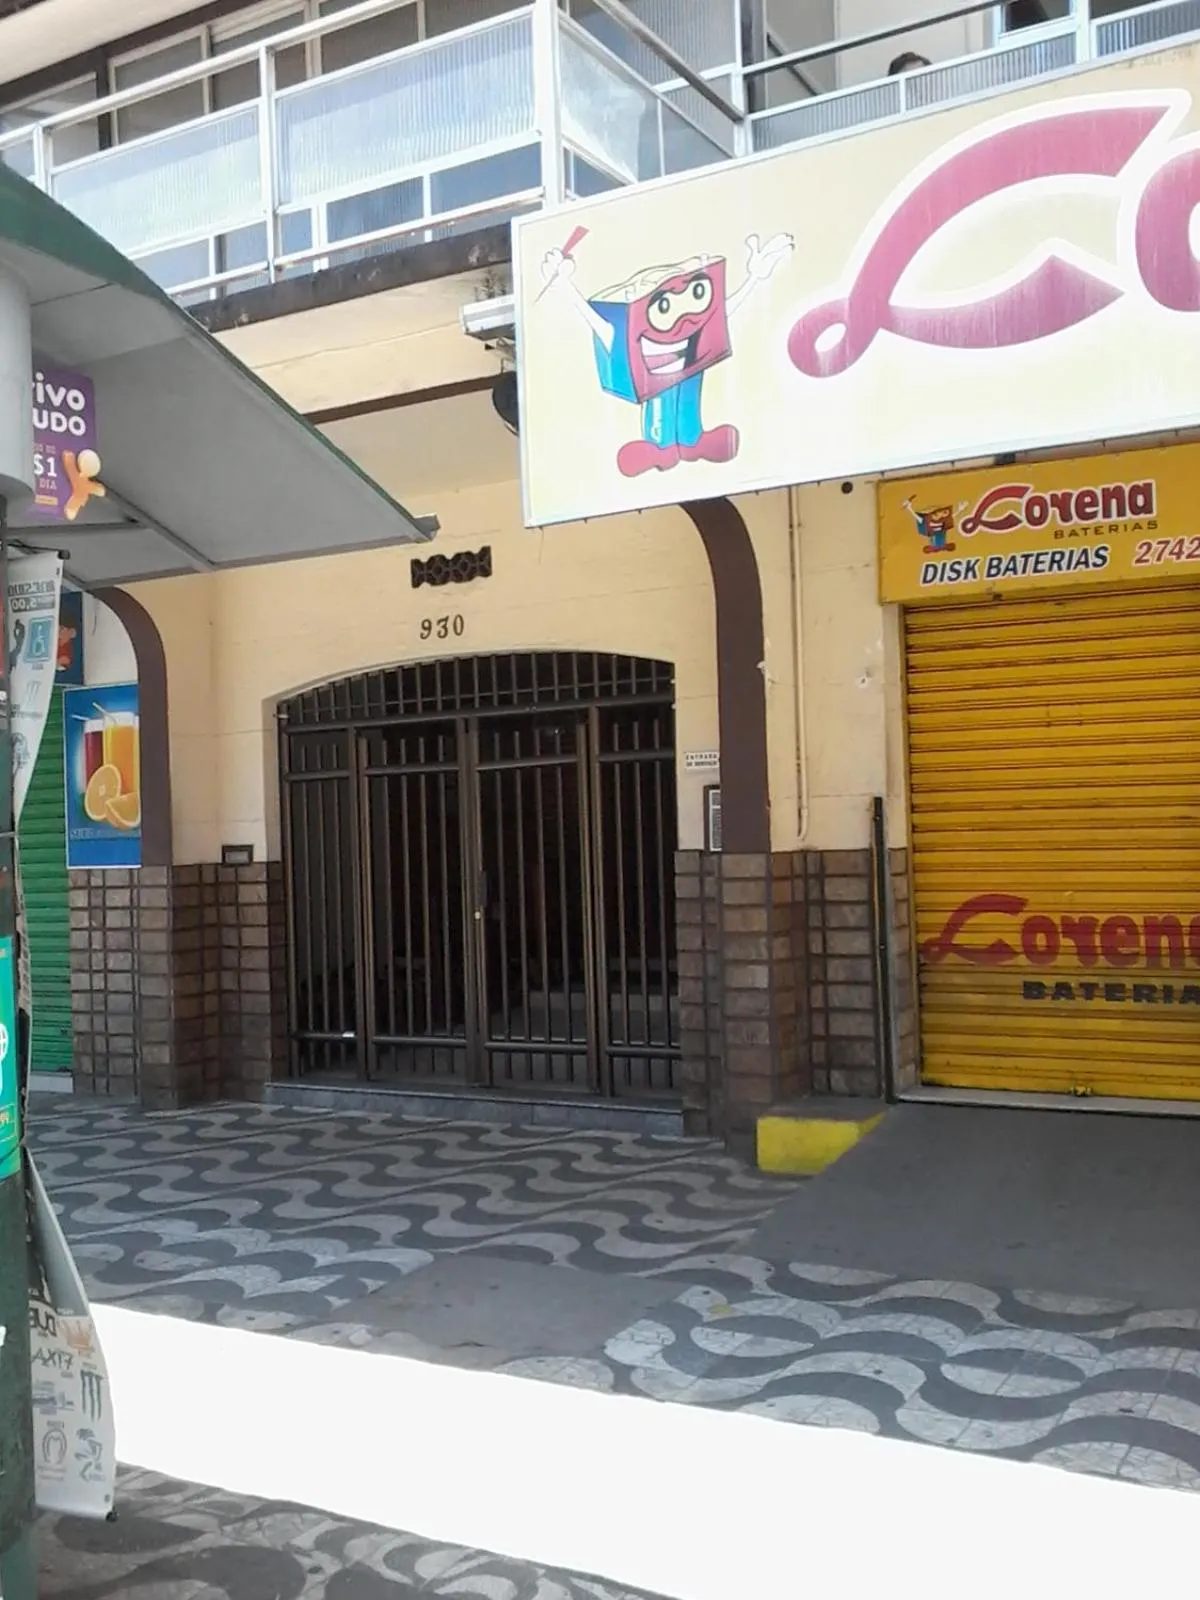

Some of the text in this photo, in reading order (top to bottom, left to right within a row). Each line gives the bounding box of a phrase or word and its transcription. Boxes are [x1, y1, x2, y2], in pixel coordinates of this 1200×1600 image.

[32, 372, 86, 411] ivo
[1054, 520, 1158, 539] BATERIAS
[921, 558, 980, 586] DISK
[986, 545, 1110, 579] BATERIAS
[419, 614, 464, 640] 930
